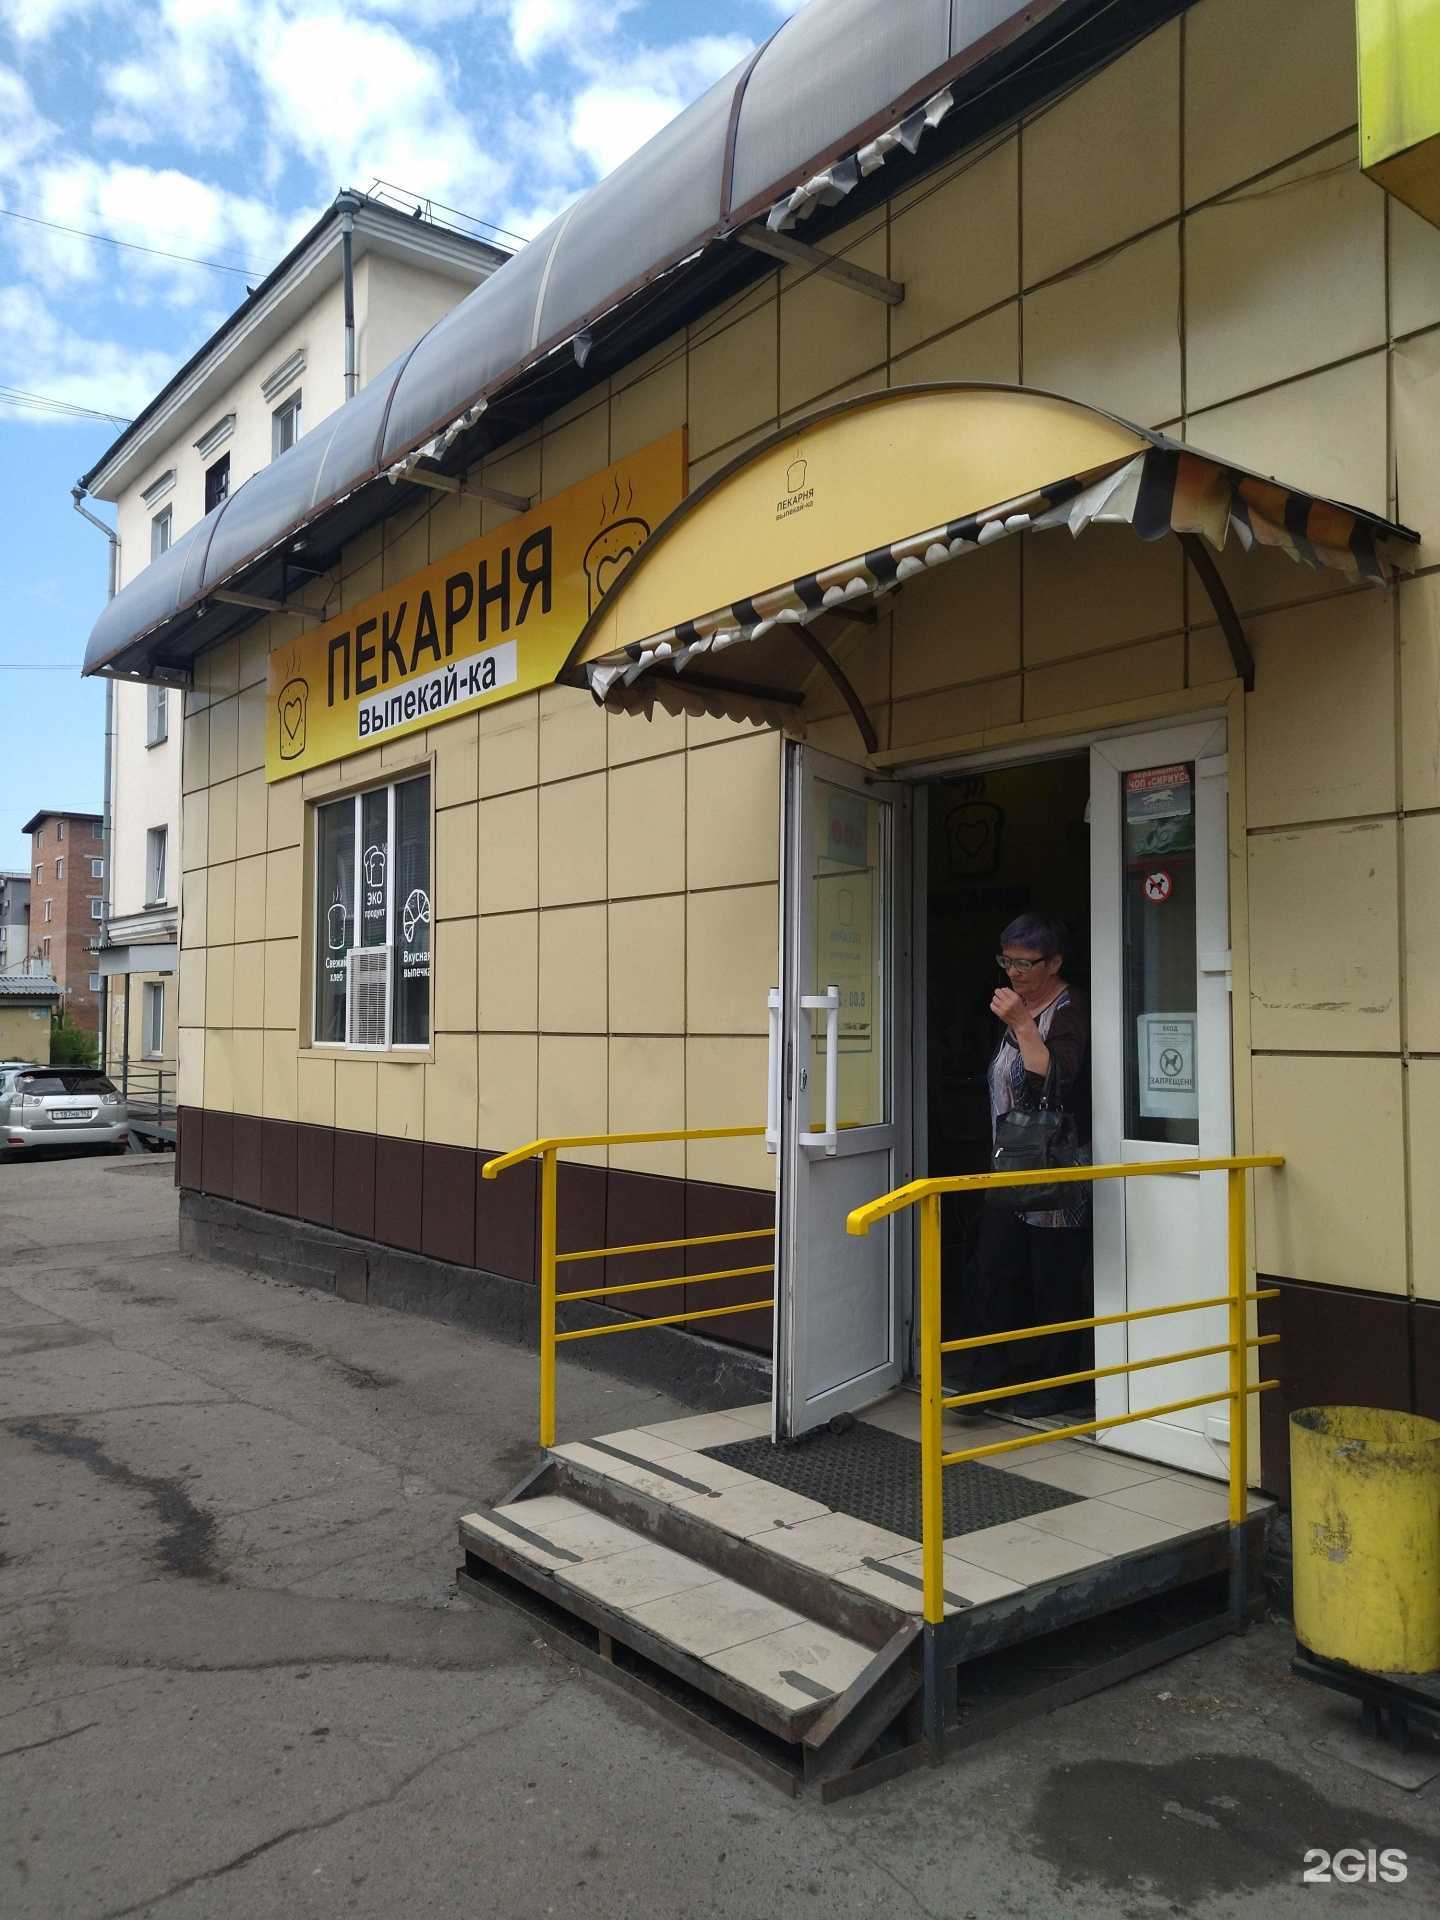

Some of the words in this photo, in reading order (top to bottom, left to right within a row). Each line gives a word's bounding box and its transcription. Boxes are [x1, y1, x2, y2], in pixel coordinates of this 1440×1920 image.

[776, 488, 814, 512] ПЕКАРНЯ
[327, 525, 553, 707] ПЕКАРНЯ
[358, 654, 497, 737] выпекай-ка
[367, 890, 383, 906] ЭКО
[403, 950, 431, 966] Вкусная
[330, 970, 344, 982] хлеб
[403, 967, 431, 978] выпечка
